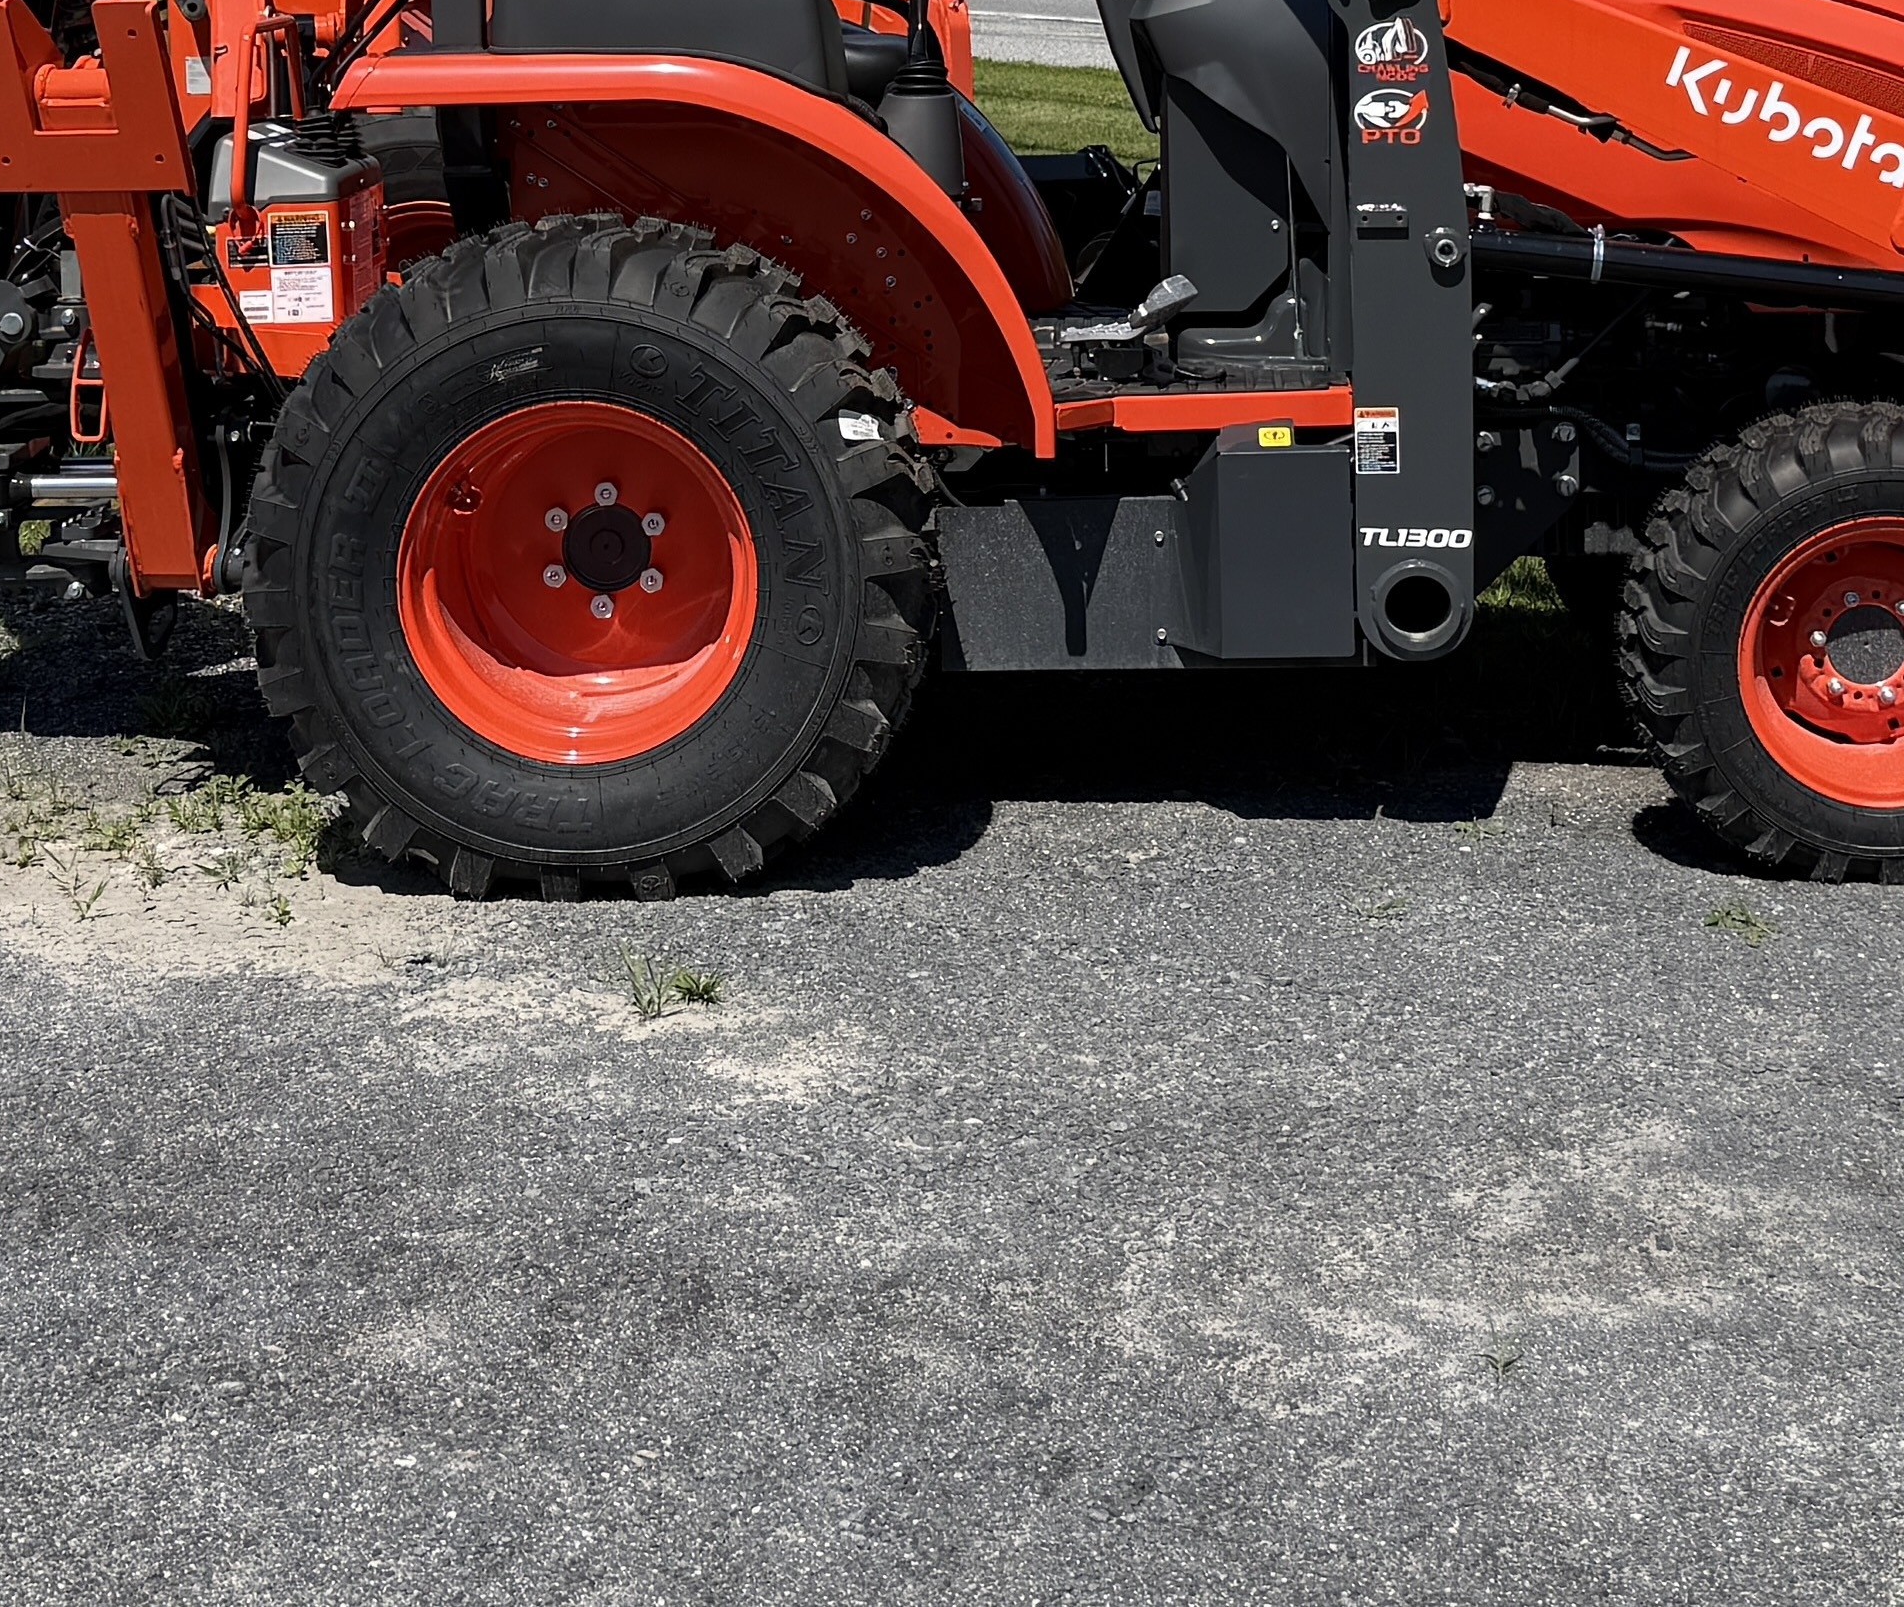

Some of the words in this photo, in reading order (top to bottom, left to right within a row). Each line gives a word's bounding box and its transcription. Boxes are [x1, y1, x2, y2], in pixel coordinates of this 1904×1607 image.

[1361, 129, 1422, 144] PTO
[675, 362, 831, 596] TITAN
[1359, 527, 1473, 548] TL1300
[328, 531, 436, 756] LOADER
[433, 762, 594, 837] TRAC
